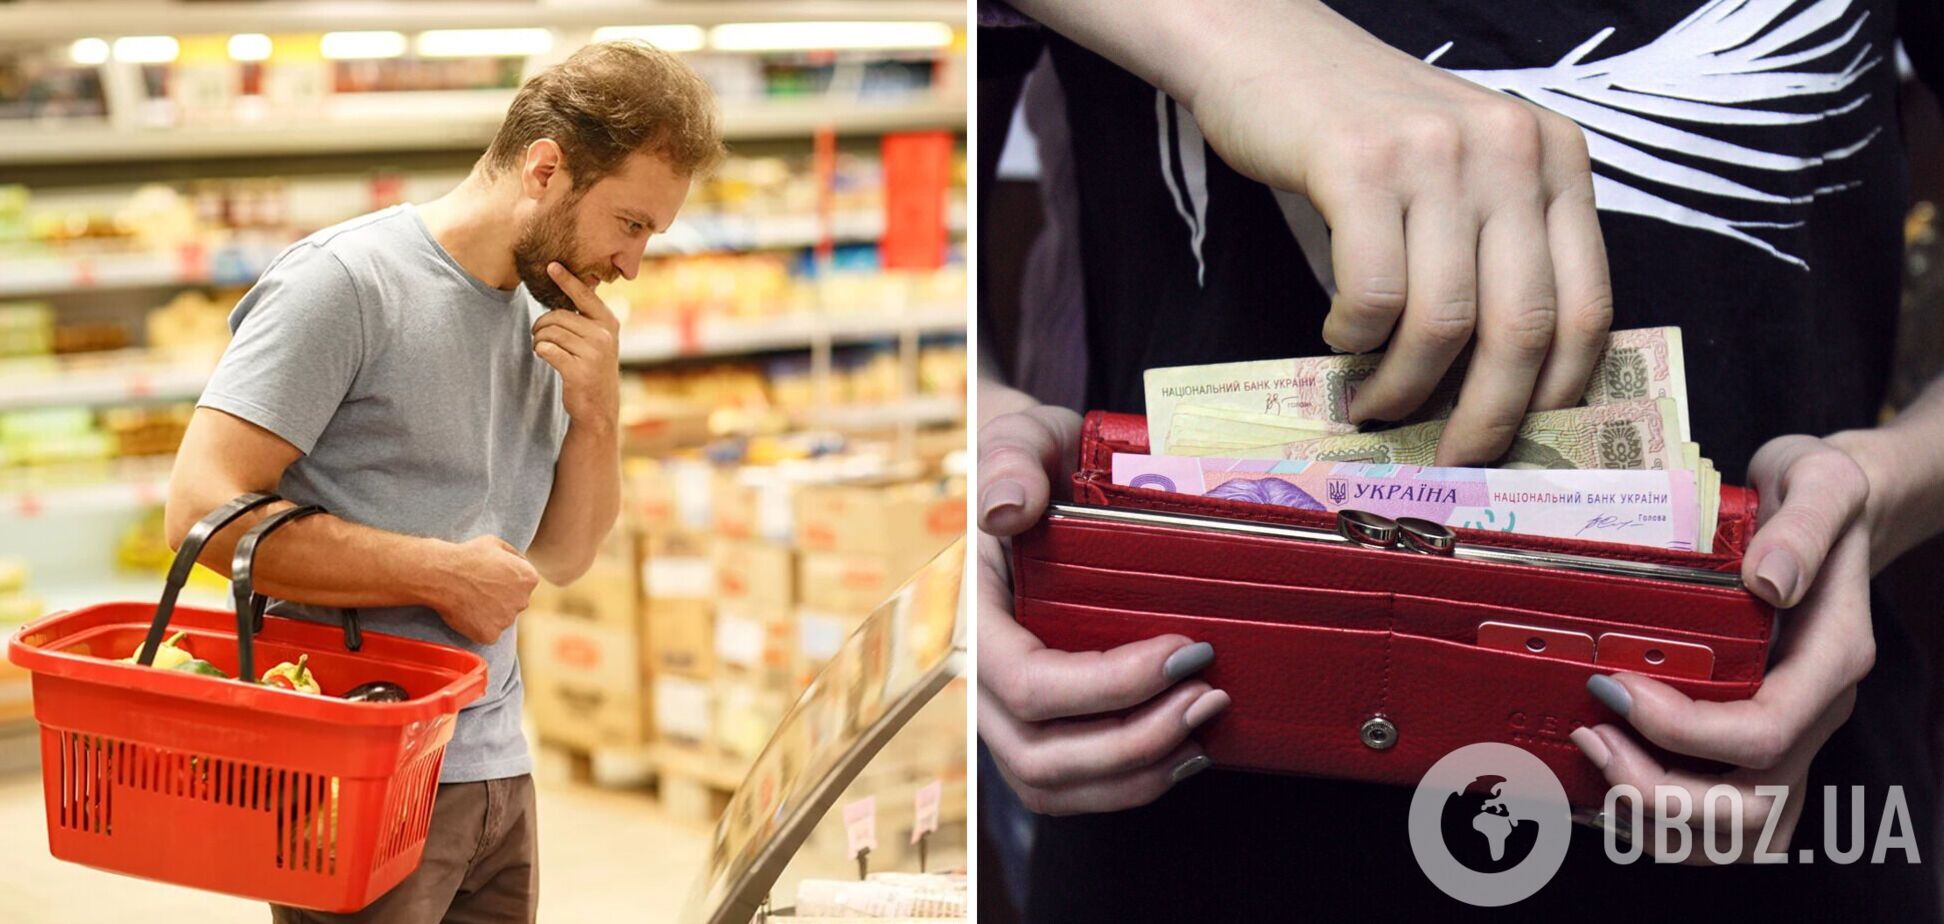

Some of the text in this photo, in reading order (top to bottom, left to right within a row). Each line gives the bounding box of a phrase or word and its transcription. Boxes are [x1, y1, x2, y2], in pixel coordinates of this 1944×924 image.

[1162, 381, 1241, 398] НАЦІОНАЛЬНИЙ
[1244, 381, 1270, 392] БАНК
[1353, 483, 1458, 504] УКРАЇНА
[1494, 491, 1668, 504] НАЦІОНАЛЬНИЙ БАНК УКРАЇНИ
